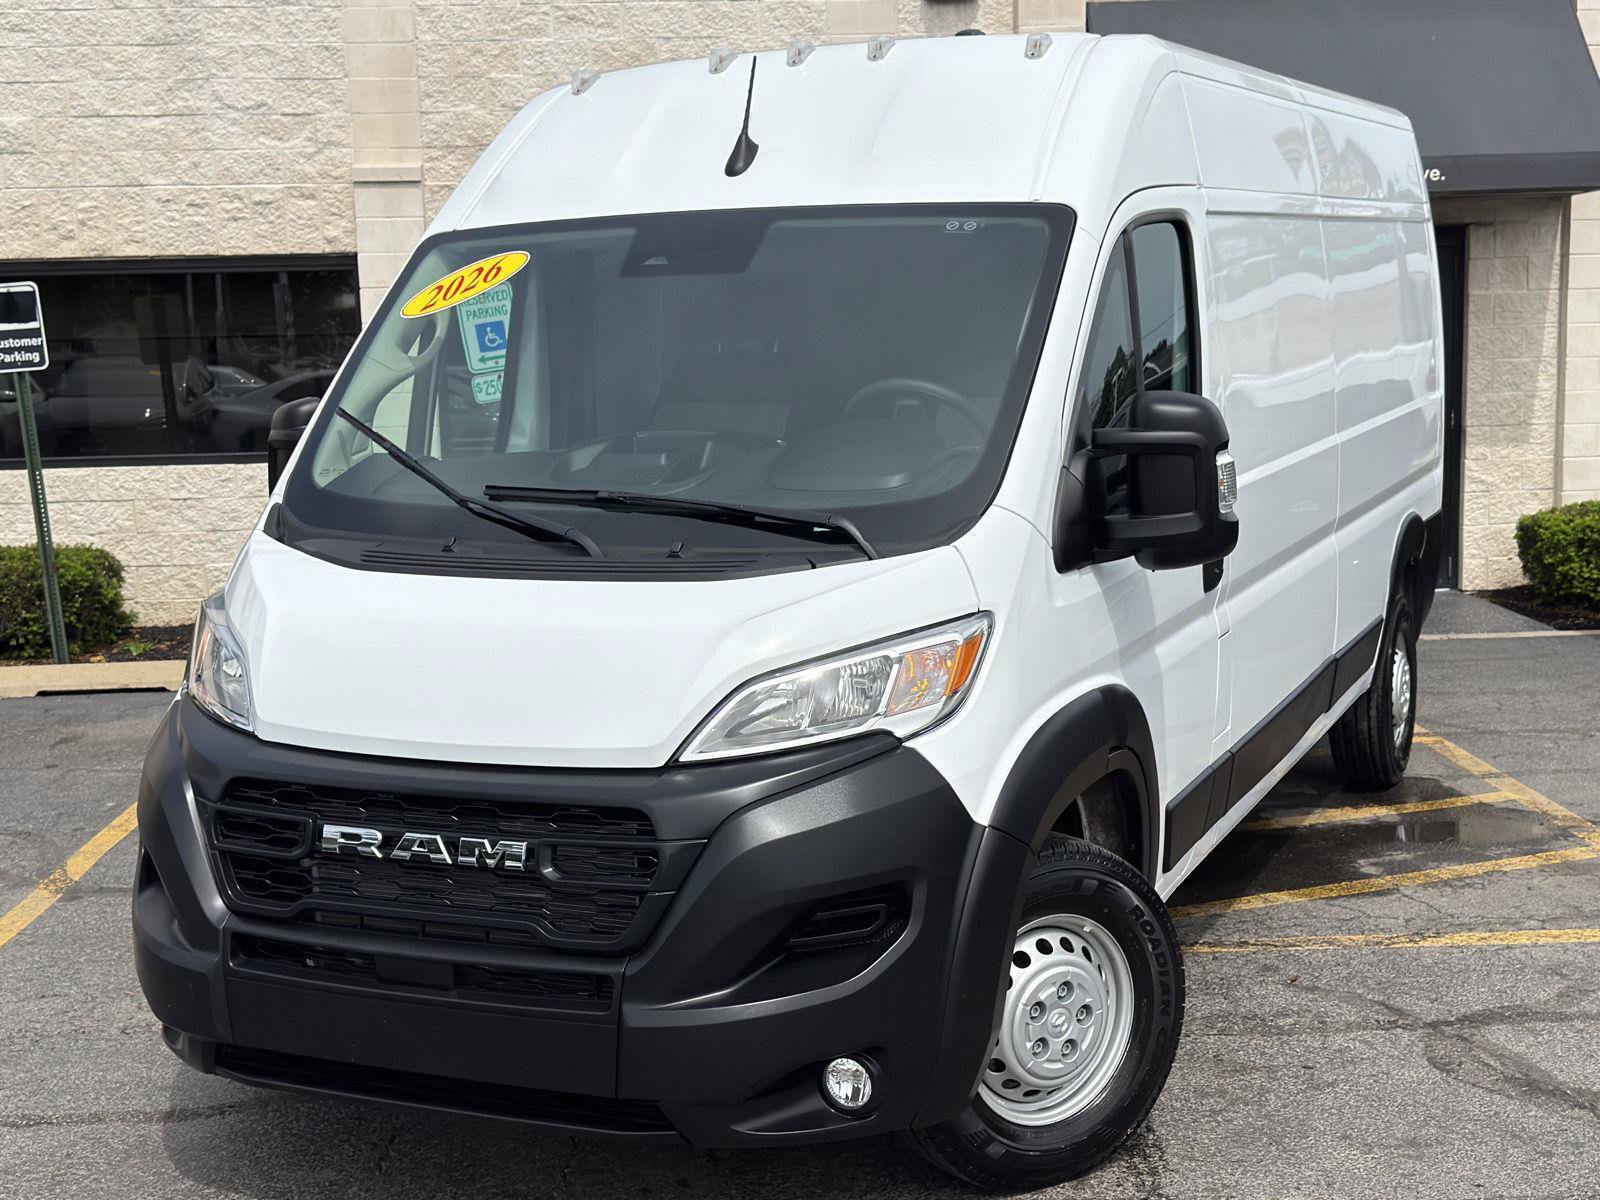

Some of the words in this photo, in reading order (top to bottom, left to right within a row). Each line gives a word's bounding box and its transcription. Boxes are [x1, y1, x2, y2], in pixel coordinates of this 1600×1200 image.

[420, 256, 508, 312] 2026
[463, 289, 508, 306] ESERVED
[466, 304, 508, 320] PARKING
[321, 824, 527, 871] RAM
[1126, 903, 1171, 1016] ROADIAN
